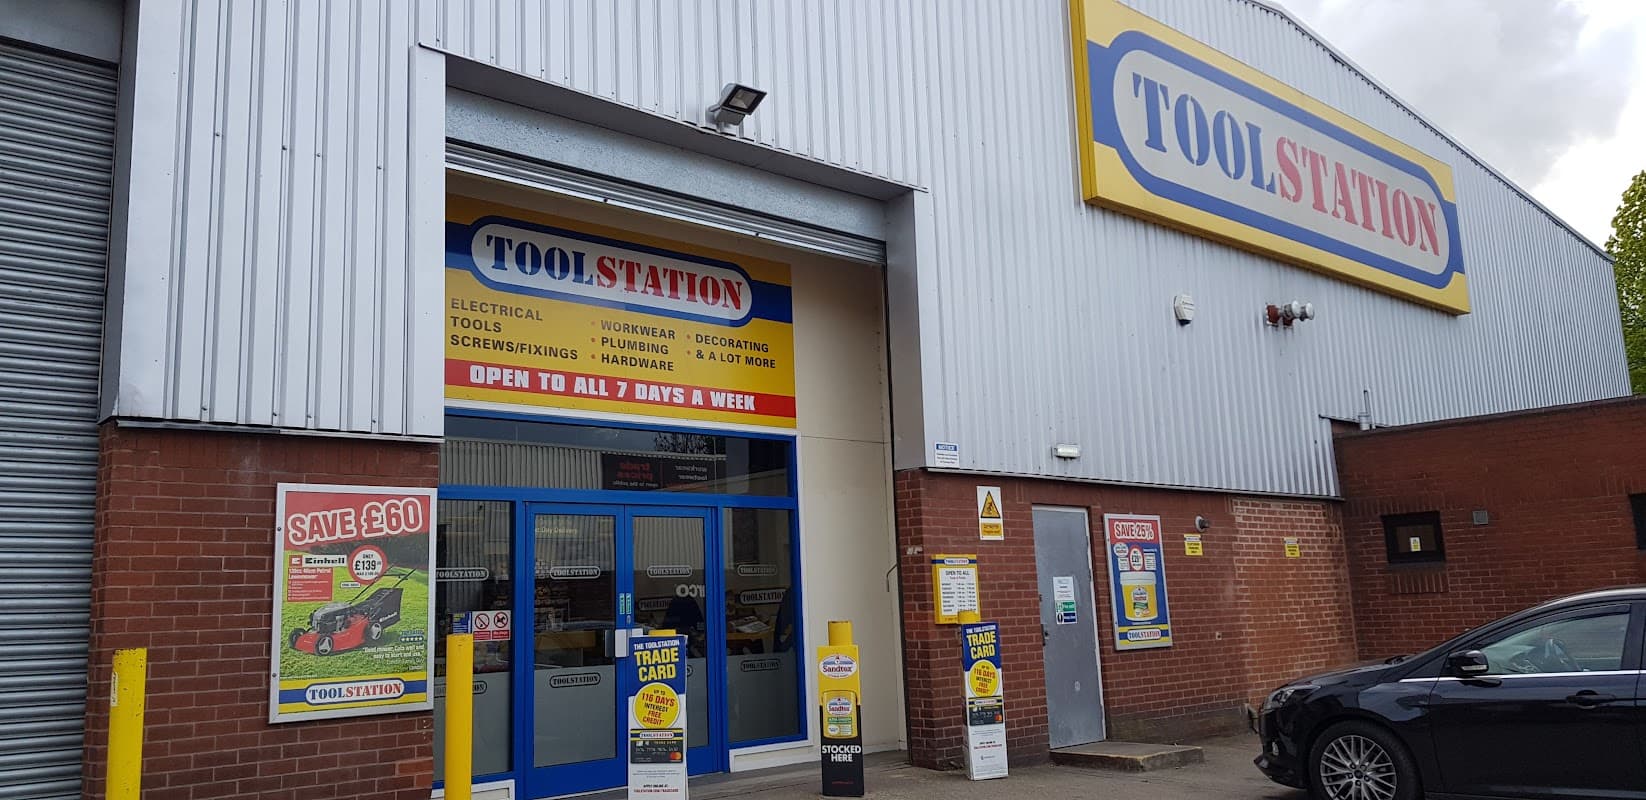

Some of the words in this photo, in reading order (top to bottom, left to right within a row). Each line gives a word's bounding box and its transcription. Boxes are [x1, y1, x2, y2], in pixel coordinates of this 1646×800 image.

[1132, 71, 1441, 256] TOOLSTATION
[485, 234, 743, 311] TOOLSTATION
[450, 298, 544, 322] ELECTRICAL
[450, 316, 503, 334] TOOLS
[600, 319, 676, 340] WORKWEAR
[449, 333, 579, 361] SCREWS/FIXINGS
[600, 336, 670, 355] PLUMBING
[694, 332, 770, 353] DECORATING
[601, 353, 675, 372] HARDWARE
[695, 348, 705, 360] &
[708, 350, 717, 361] A
[719, 351, 742, 365] LOT
[744, 353, 777, 369] MORE
[469, 364, 530, 389] OPEN
[538, 371, 566, 392] TO
[573, 376, 609, 398] ALL
[616, 381, 628, 398] 7
[634, 382, 685, 405] DAYS
[691, 387, 704, 406] A
[709, 390, 756, 411] WEEK
[288, 508, 357, 545] SAVE
[361, 498, 422, 537] £60
[1114, 522, 1135, 538] SAVE
[1136, 523, 1154, 540] 25%
[354, 560, 377, 571] £139
[552, 568, 599, 577] TOOLSTATION
[649, 567, 691, 576] TOOLSTATION
[645, 639, 680, 649] TOOLSTATION
[966, 631, 997, 647] TRADE
[1128, 630, 1160, 640] TOOLSTATION
[633, 647, 680, 666] TRADE
[970, 644, 996, 660] CARD
[638, 664, 677, 682] CARD
[742, 660, 780, 670] TOOLSTATION
[552, 675, 599, 686] TOOLSTATION
[308, 682, 402, 701] TOOLSTATION
[644, 702, 669, 713] INTEREST
[655, 695, 675, 707] DAYS
[647, 710, 662, 719] FREE
[821, 744, 862, 754] STOCKED
[830, 753, 853, 763] HERE
